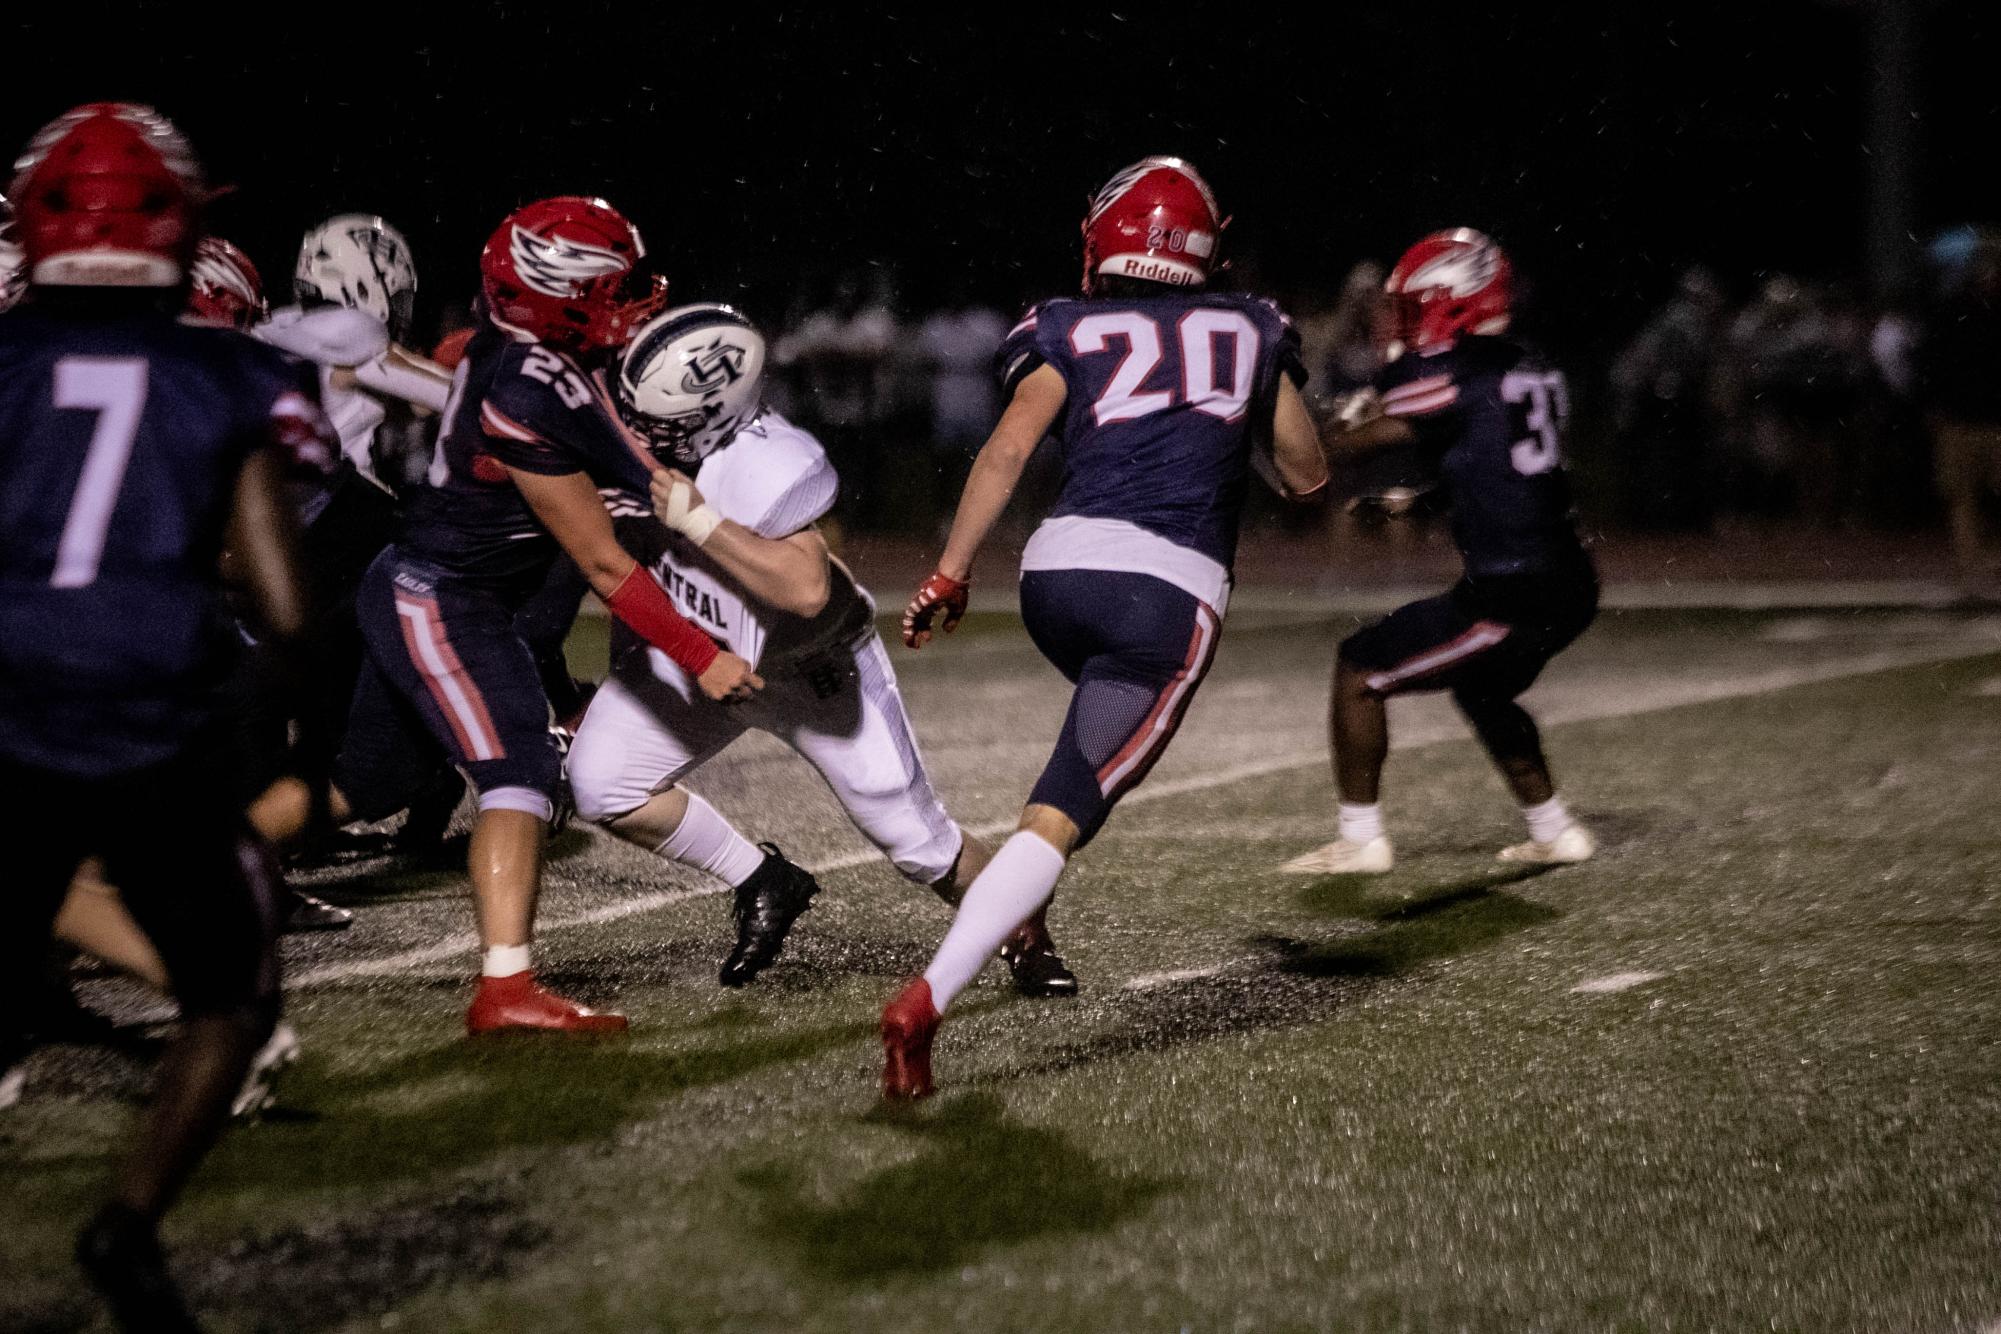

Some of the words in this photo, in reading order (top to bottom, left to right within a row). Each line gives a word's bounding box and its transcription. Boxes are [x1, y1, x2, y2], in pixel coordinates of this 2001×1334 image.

[1124, 259, 1194, 286] Riddell
[1146, 225, 1185, 253] 20
[520, 344, 593, 411] 23
[1068, 310, 1260, 427] 20
[51, 355, 150, 589] 7
[654, 558, 728, 631] NTRAL
